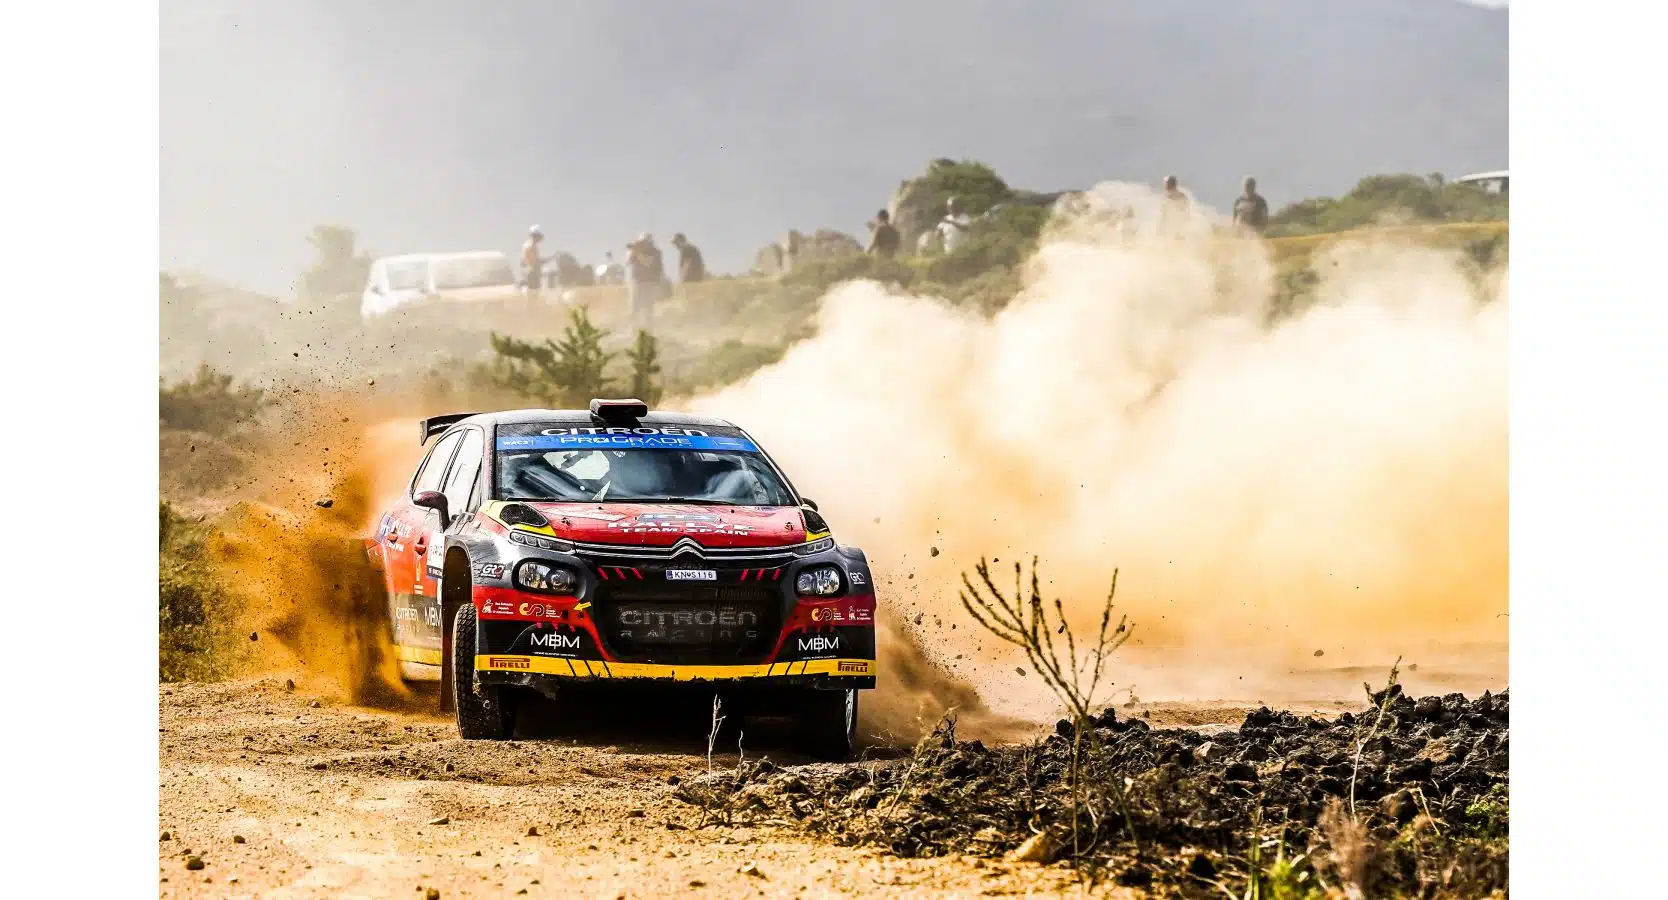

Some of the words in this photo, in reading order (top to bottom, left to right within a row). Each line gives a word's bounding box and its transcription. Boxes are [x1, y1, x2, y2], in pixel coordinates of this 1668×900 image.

[540, 426, 709, 437] CITROËN
[560, 436, 692, 446] PROGRADE
[685, 528, 748, 536] SPAIN
[619, 607, 757, 625] CITROËN
[530, 630, 580, 650] MBM
[798, 634, 839, 652] MBM
[489, 657, 530, 669] PIRELLI
[838, 661, 868, 673] PIRELLI
